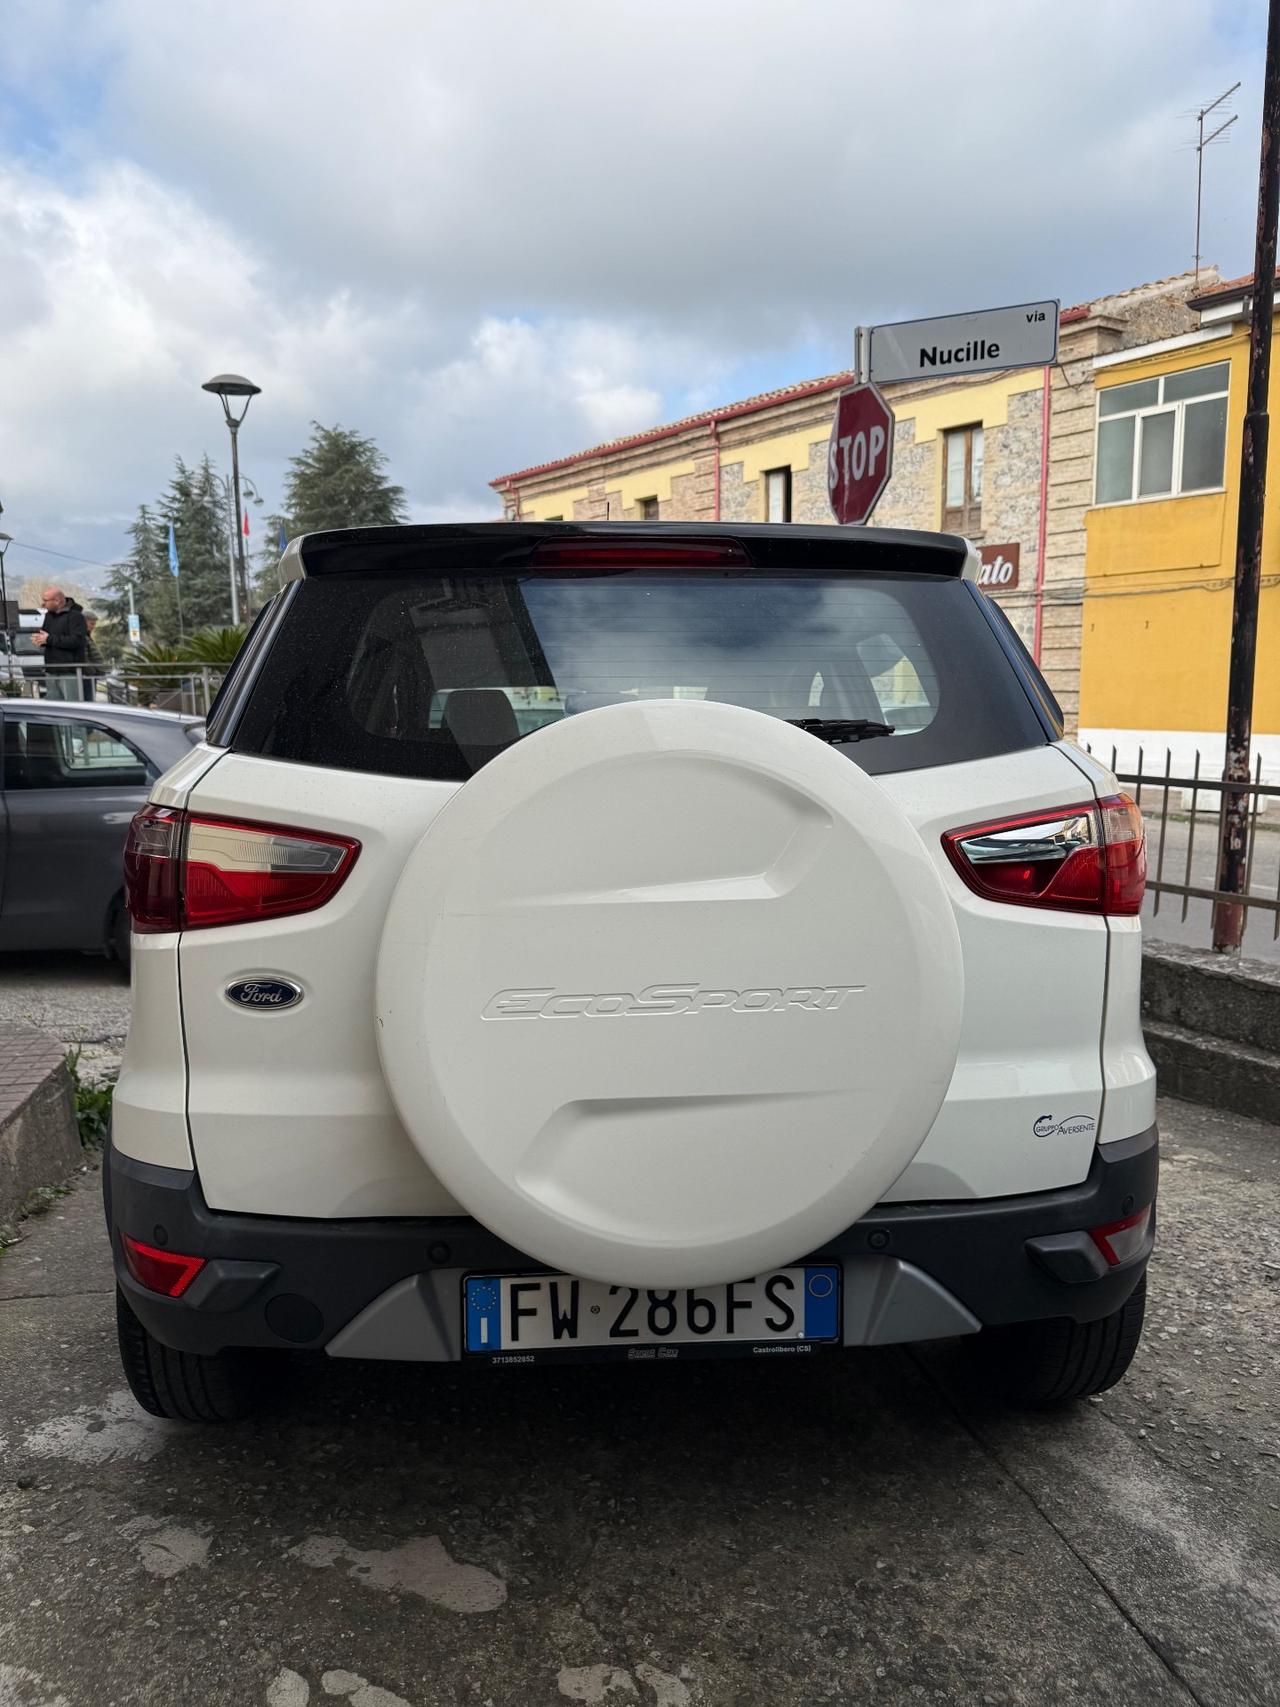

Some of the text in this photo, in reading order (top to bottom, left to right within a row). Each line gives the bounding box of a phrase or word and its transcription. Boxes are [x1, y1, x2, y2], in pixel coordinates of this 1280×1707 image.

[1026, 310, 1046, 323] via
[919, 339, 1000, 368] Nucille
[829, 425, 885, 489] STOP
[240, 983, 283, 1003] Ford
[753, 1346, 796, 1354] Castrolibero
